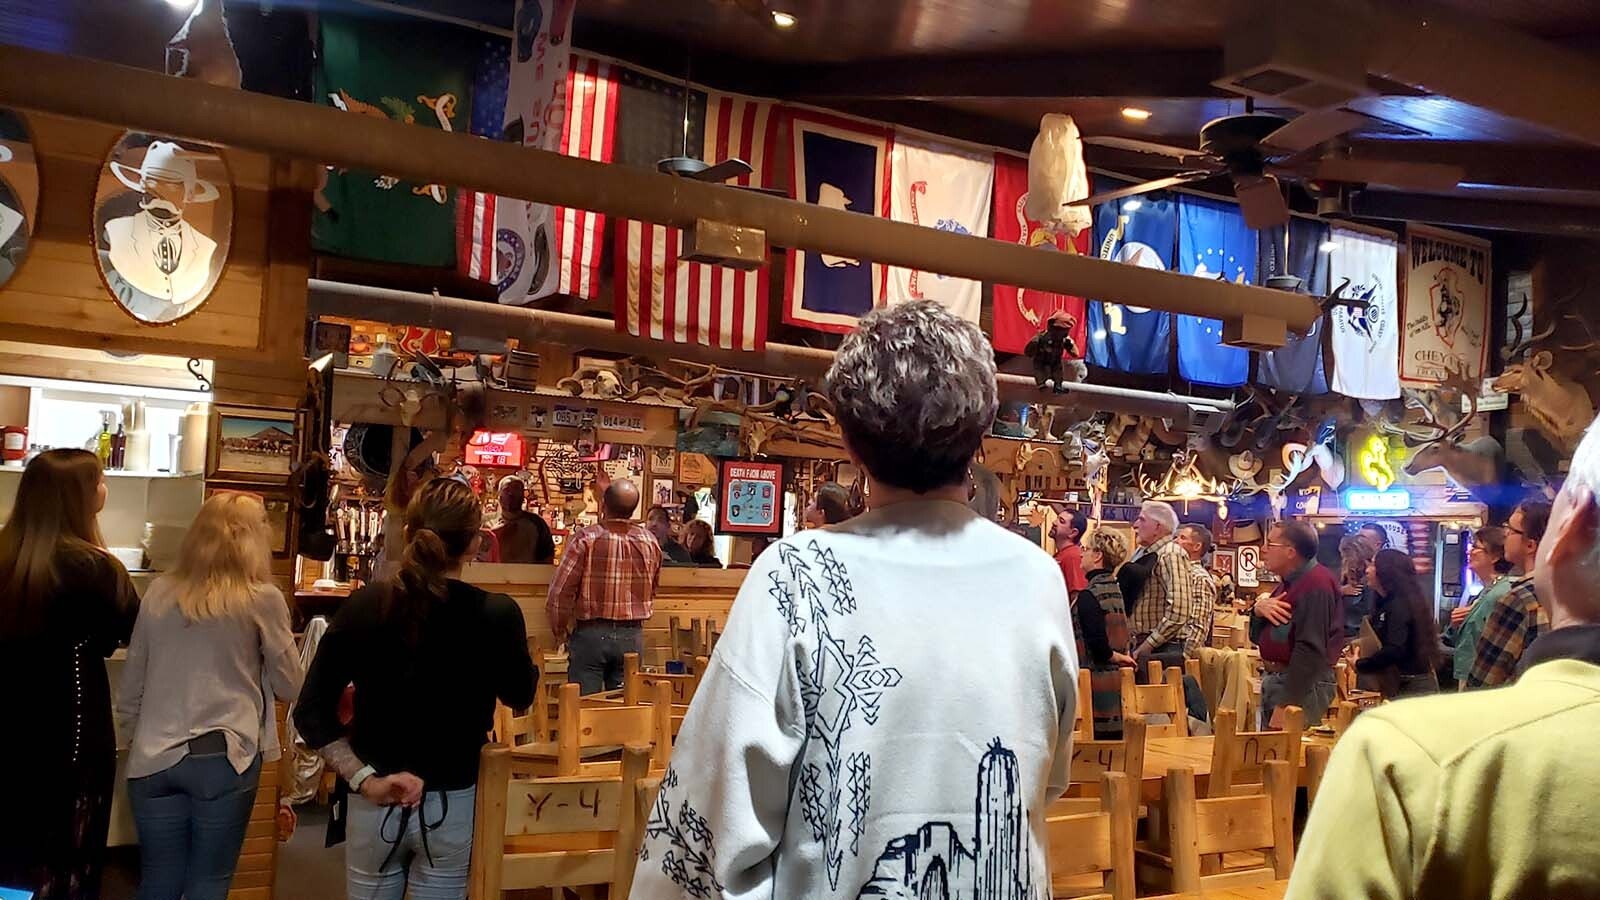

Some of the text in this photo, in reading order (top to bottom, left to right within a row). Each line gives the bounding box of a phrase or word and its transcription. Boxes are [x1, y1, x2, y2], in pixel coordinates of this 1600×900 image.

[1103, 233, 1115, 259] UNITED
[1411, 238, 1467, 270] WELCOME
[1468, 248, 1484, 286] TO
[729, 468, 776, 480] DEATH FROM ABOVE
[527, 788, 600, 822] Y-4
